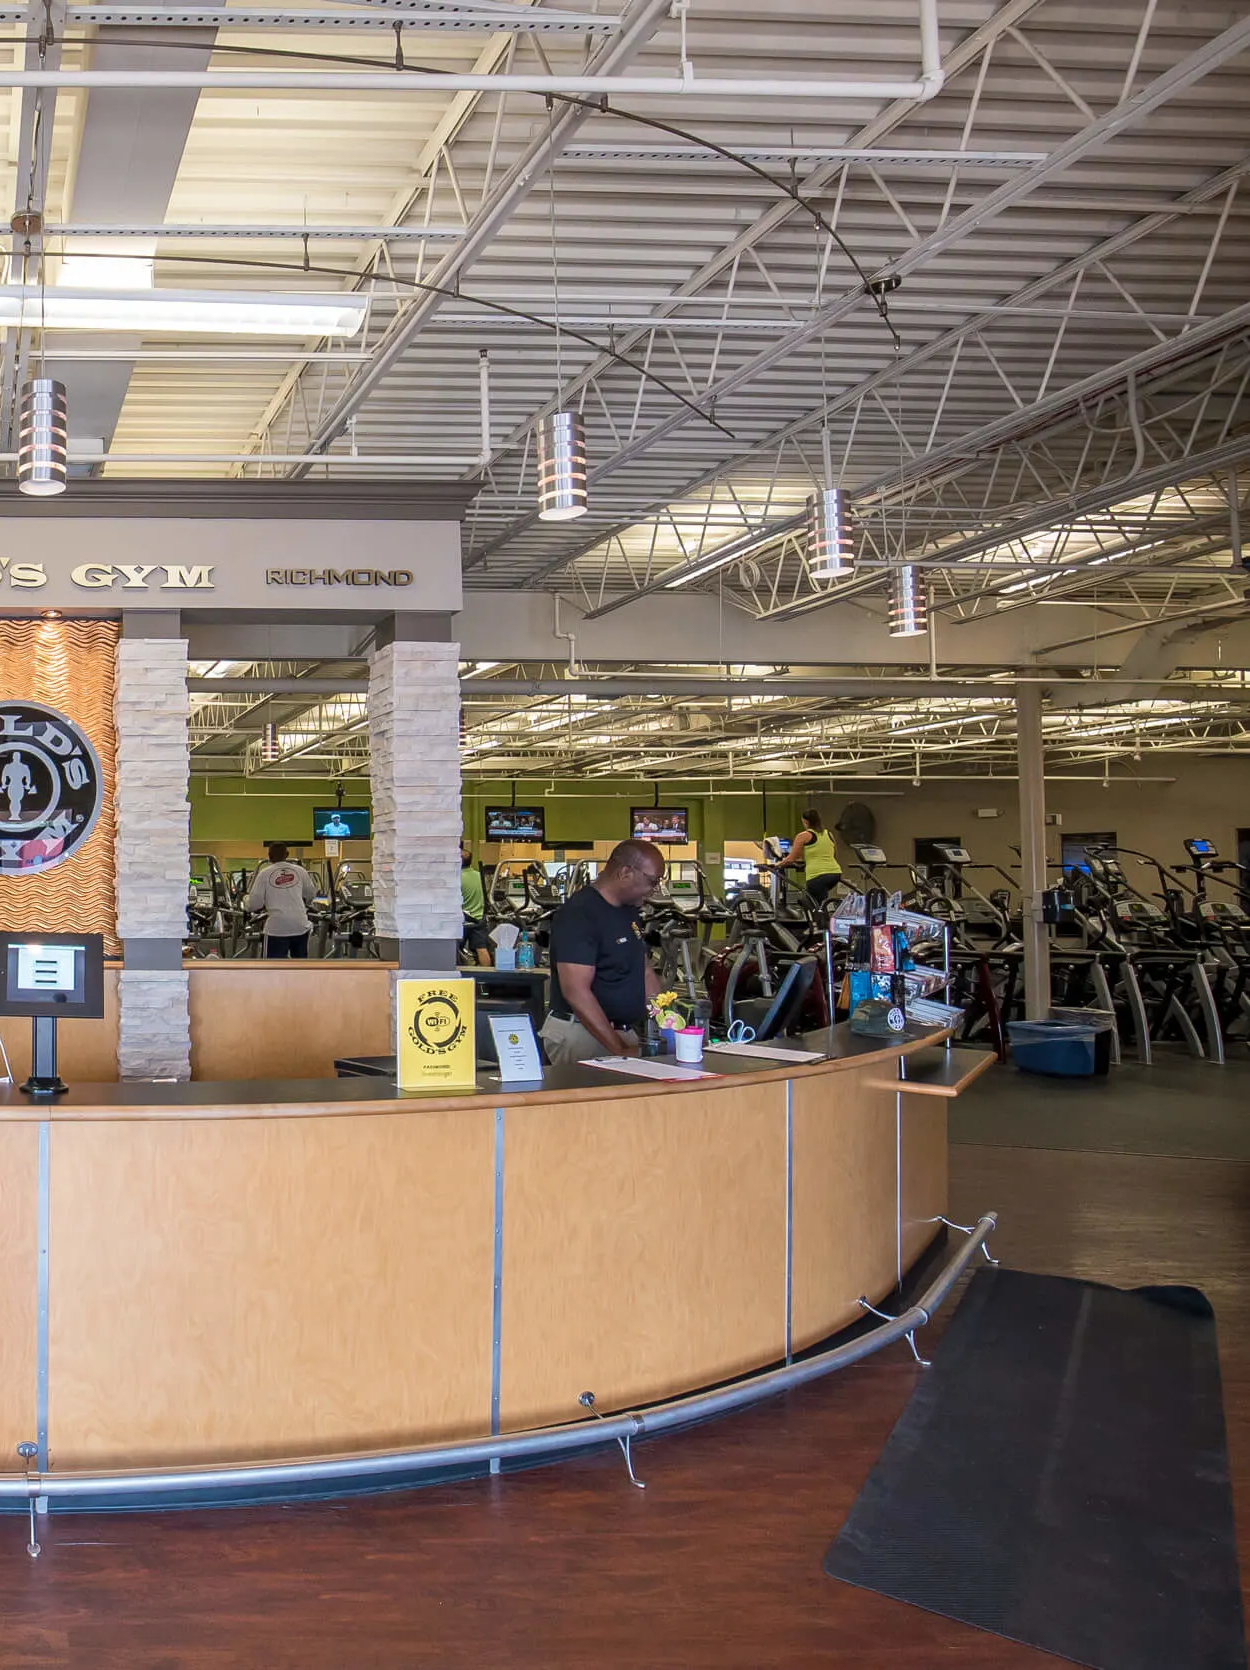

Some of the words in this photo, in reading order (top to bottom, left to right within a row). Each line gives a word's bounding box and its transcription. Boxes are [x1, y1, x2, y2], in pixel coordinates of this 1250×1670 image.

[70, 563, 215, 588] GYM
[266, 568, 414, 586] RICHMOND
[417, 989, 458, 1003] FREE
[408, 1026, 446, 1055] GOLD'S
[447, 1025, 467, 1051] GYM
